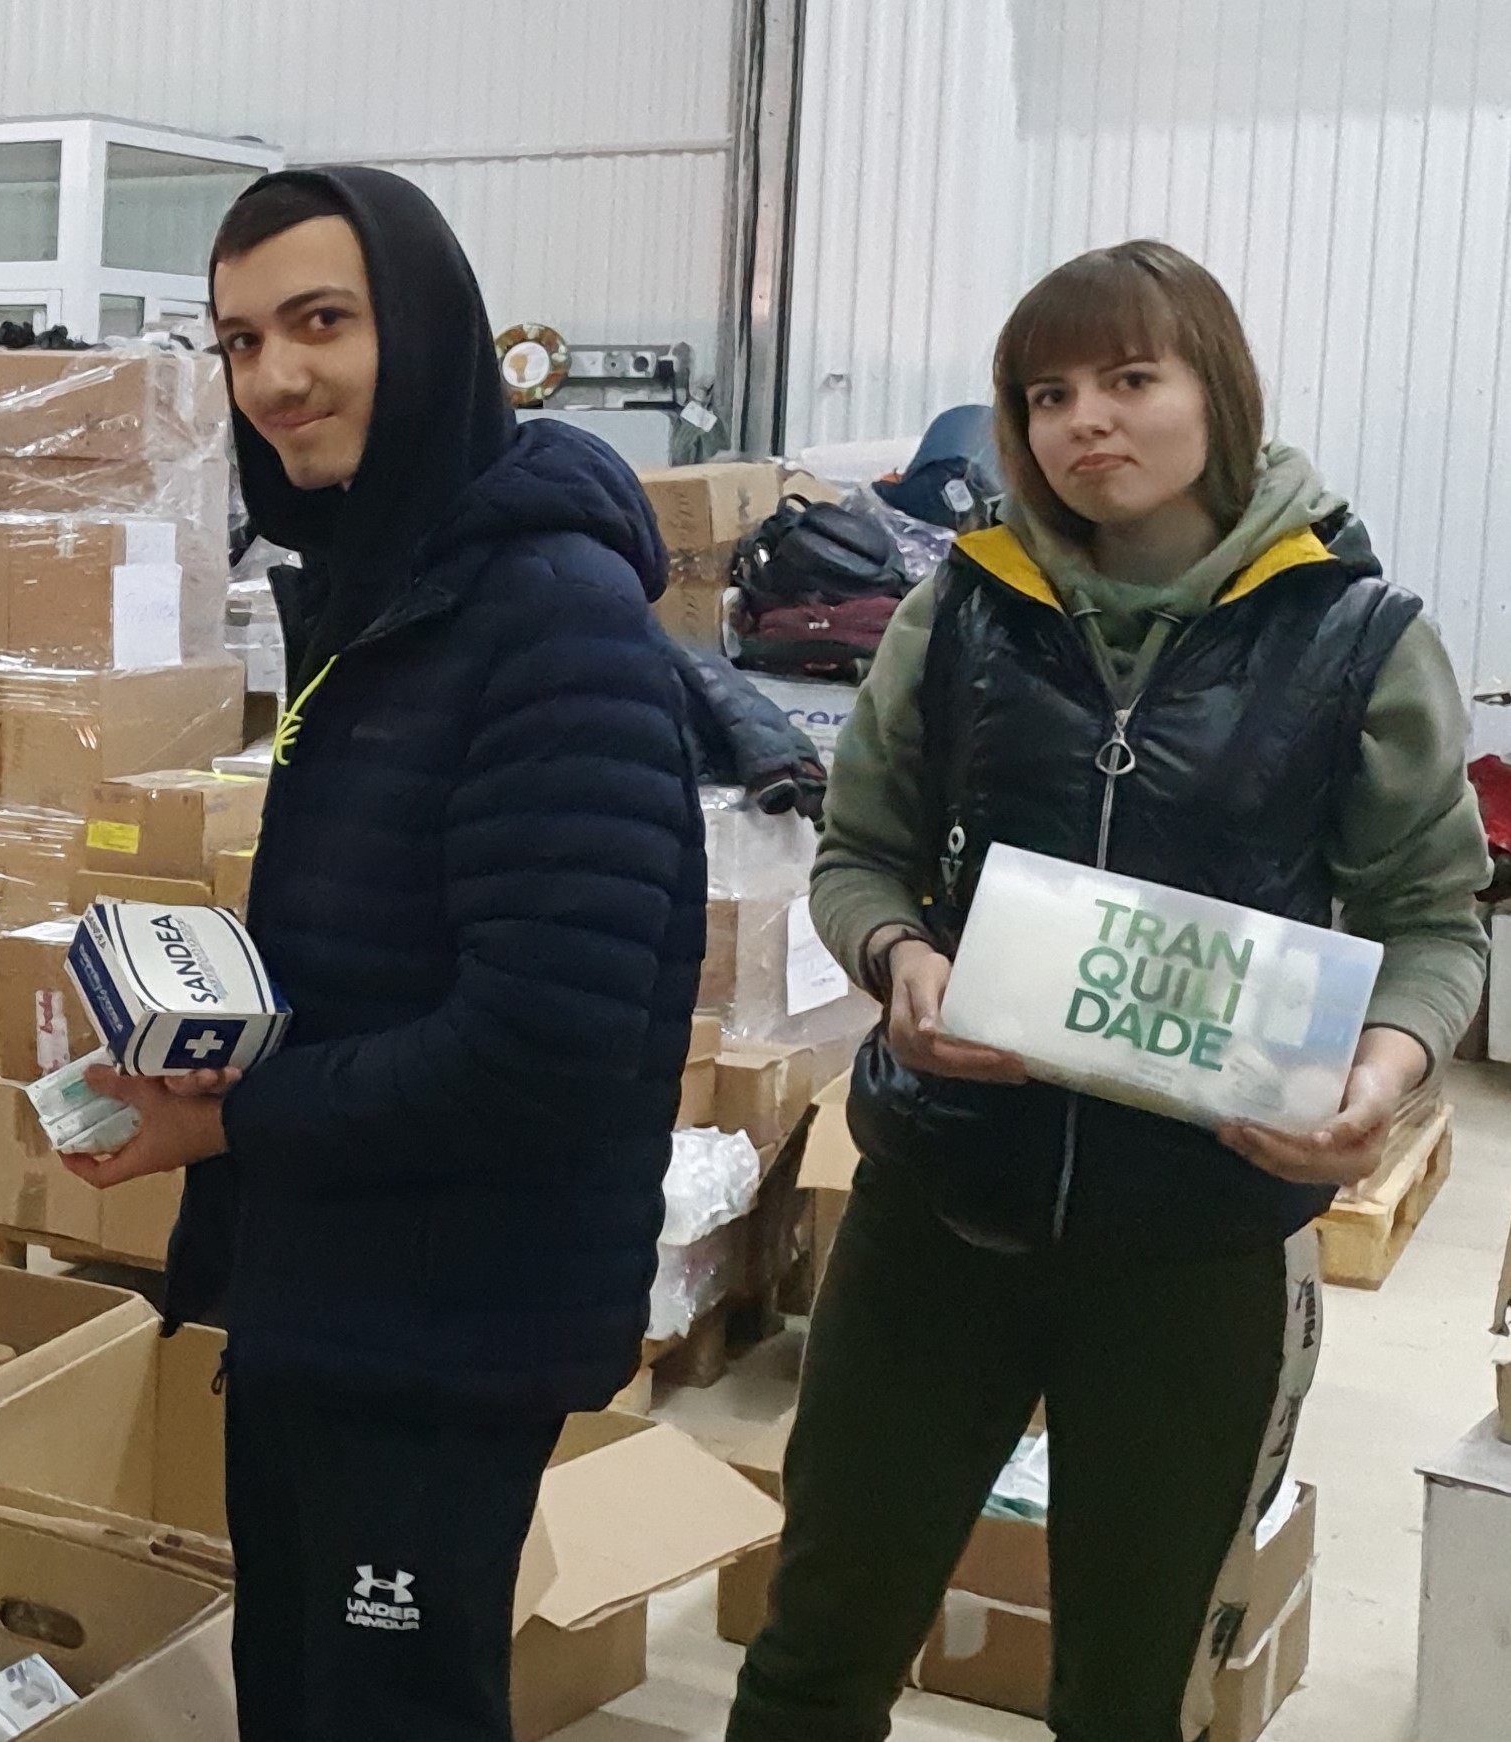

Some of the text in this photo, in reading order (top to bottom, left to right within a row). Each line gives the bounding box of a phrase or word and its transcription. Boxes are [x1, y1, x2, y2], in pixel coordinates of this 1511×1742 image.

[150, 914, 219, 1004] SANDEA
[1093, 898, 1255, 979] TRAN
[1078, 946, 1242, 1025] QUILI
[1064, 987, 1234, 1072] DADE
[346, 1596, 420, 1621] UNDER
